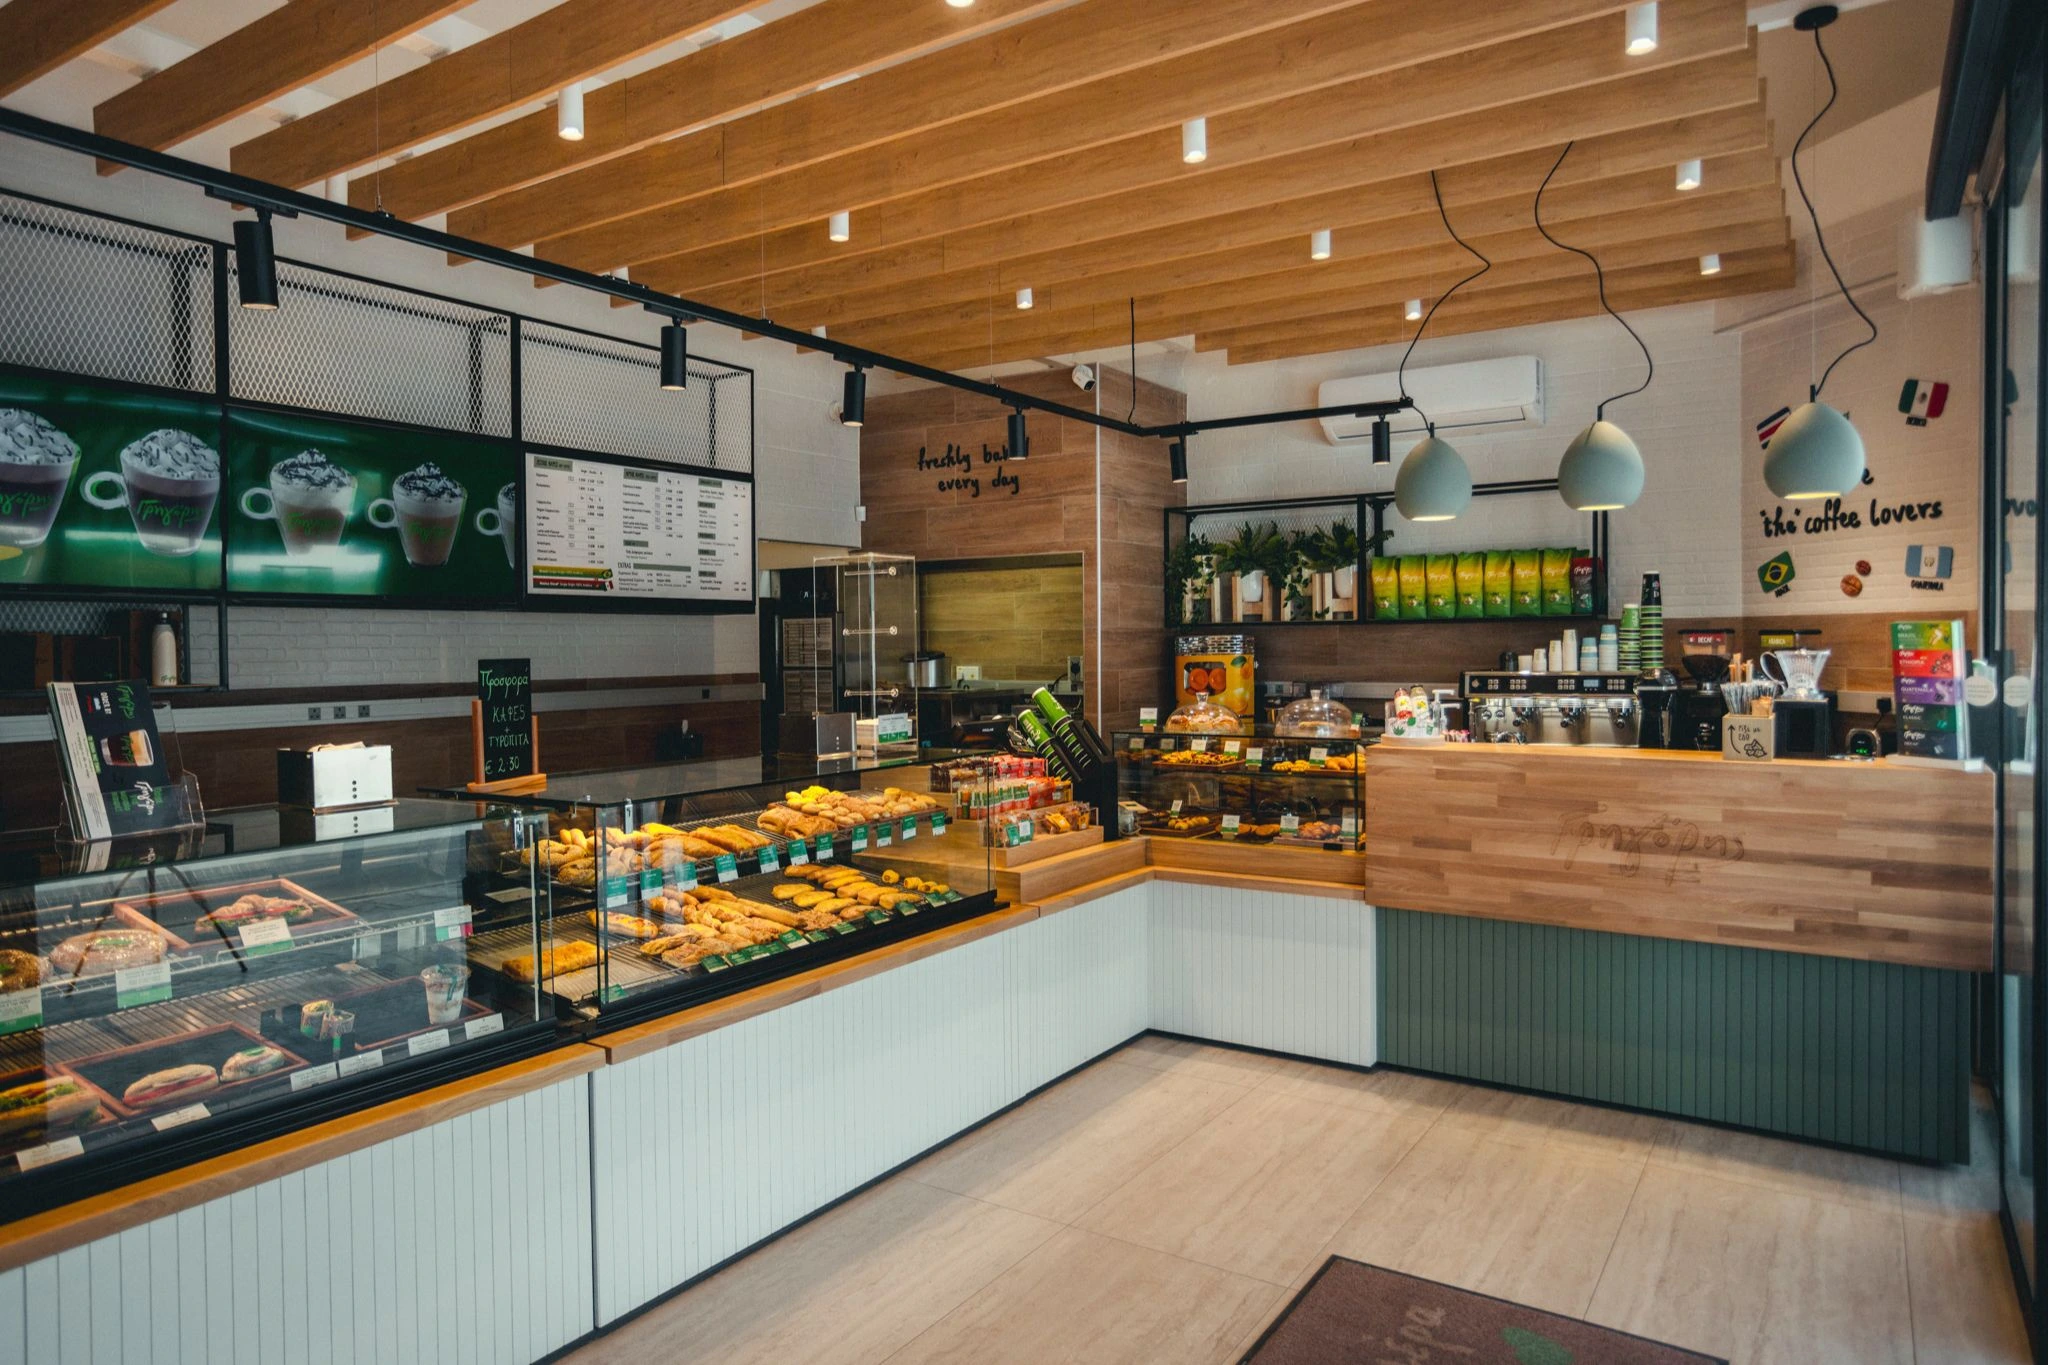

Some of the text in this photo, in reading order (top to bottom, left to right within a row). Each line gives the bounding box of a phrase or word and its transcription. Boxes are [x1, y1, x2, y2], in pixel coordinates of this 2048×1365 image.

[917, 443, 971, 473] freshly
[938, 466, 1019, 498] every day
[1804, 499, 1861, 534] coffee
[1870, 499, 1942, 527] lovers
